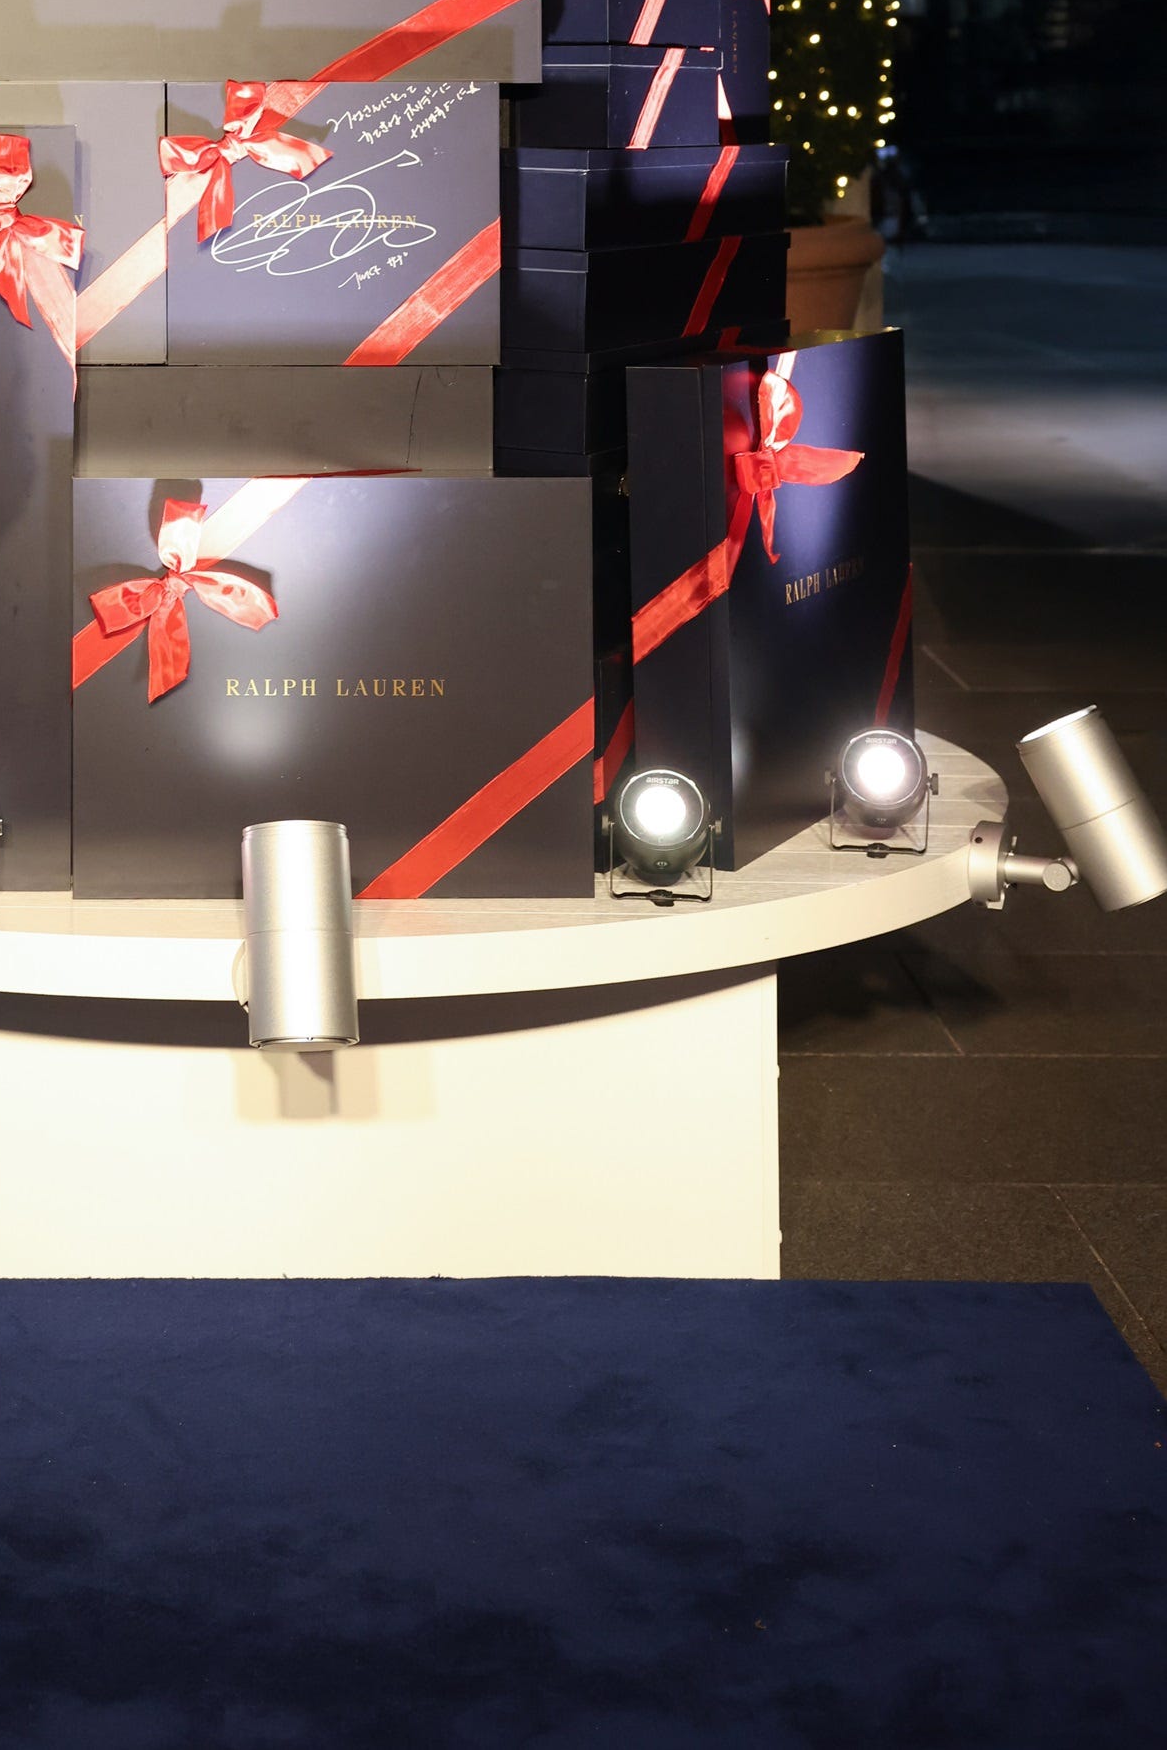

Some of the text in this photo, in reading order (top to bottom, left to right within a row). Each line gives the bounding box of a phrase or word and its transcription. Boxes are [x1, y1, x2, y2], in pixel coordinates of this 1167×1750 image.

[253, 213, 417, 229] RALPH LAUREN
[785, 572, 821, 606] RALPH
[226, 678, 445, 696] RALPH LAUREN
